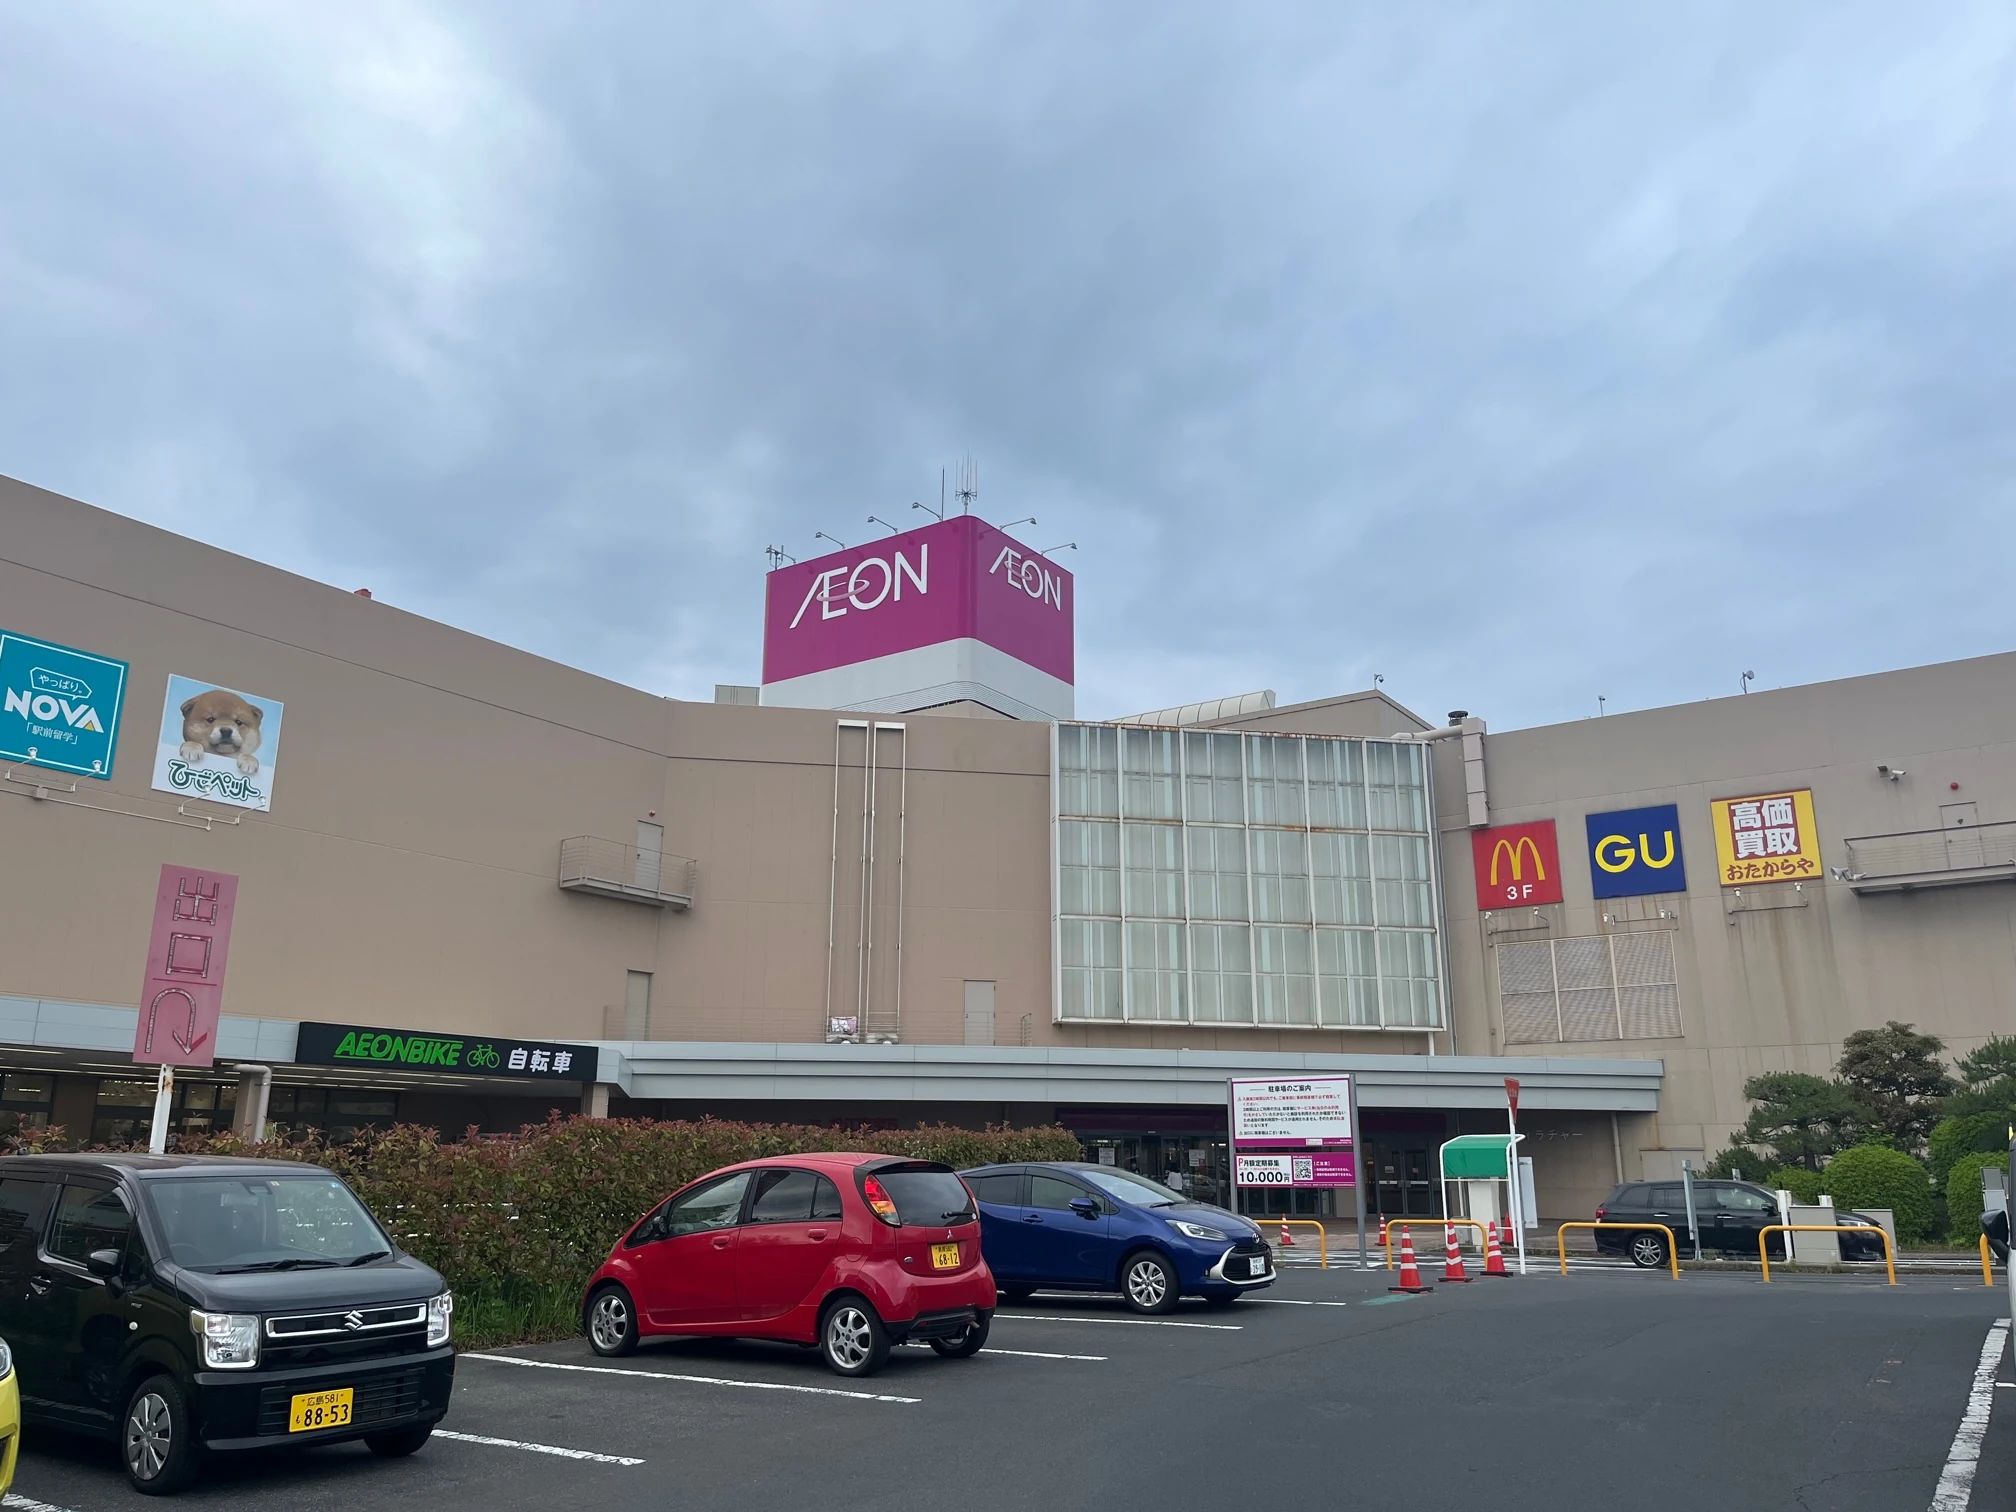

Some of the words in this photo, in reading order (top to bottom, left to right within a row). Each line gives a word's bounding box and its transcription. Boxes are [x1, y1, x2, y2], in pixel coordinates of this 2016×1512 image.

[4, 686, 104, 733] NOVA
[1730, 797, 1793, 831] 高価
[1595, 830, 1675, 874] GU
[1736, 828, 1799, 859] 買取
[1726, 857, 1814, 881] おたからや
[166, 877, 220, 979] 出口
[334, 1031, 464, 1066] AEONBIKE
[507, 1048, 573, 1074] 自転車
[304, 1404, 348, 1426] 88-53
